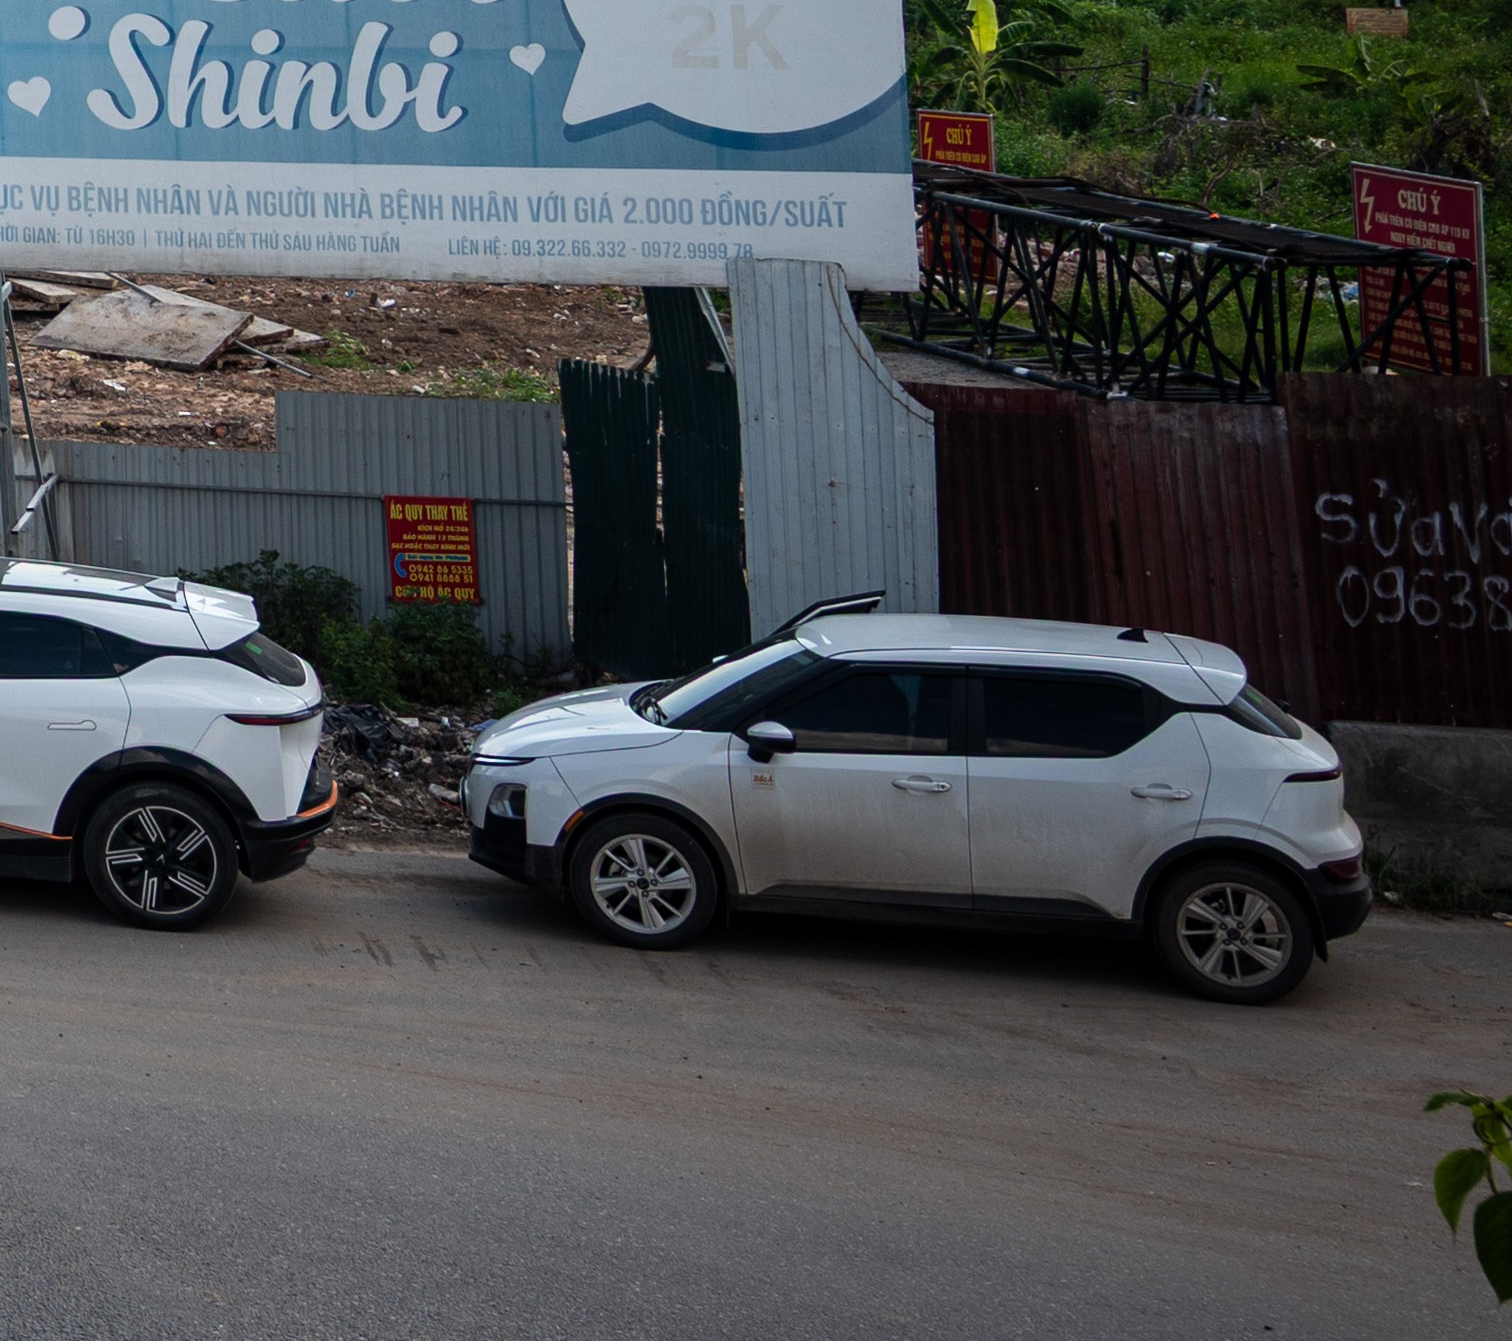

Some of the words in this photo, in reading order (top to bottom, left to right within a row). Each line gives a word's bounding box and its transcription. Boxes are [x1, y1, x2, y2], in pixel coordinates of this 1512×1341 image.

[670, 5, 791, 71] 2K
[86, 11, 467, 134] Shinbi
[946, 124, 964, 145] CHÚ
[965, 124, 972, 146] Ý
[29, 185, 61, 217] VỤ
[66, 180, 129, 218] BỆNH
[135, 181, 201, 215] NHÂN
[207, 184, 239, 216] VÀ
[245, 185, 316, 219] NGƯỜI
[322, 183, 373, 220] NHÀ
[380, 188, 444, 226] BỆNH
[451, 189, 518, 223] NHÂN
[526, 190, 566, 224] VỚI
[573, 189, 614, 225] GIÁ
[623, 197, 694, 226] 2.000
[700, 190, 848, 229] ĐỒNG/SUẤT
[1397, 187, 1427, 213] CHÚ
[1430, 189, 1441, 215] Ý
[22, 226, 61, 245] GIAN:
[64, 224, 85, 245] TỪ
[88, 229, 136, 247] 16H30
[155, 226, 184, 249] THỨ
[187, 231, 213, 249] HAI
[216, 225, 247, 250] ĐẾN
[250, 226, 280, 251] THỨ
[282, 228, 313, 252] SÁU
[316, 228, 358, 253] HÀNG
[360, 230, 400, 254] TUẦN
[447, 232, 480, 256] LIÊN
[511, 238, 626, 259] 09.322.66.332
[641, 240, 754, 260] 0972.999978
[405, 504, 423, 522] QUY
[425, 504, 448, 521] THAY
[409, 564, 434, 573] 0942
[410, 573, 434, 582] 0941
[454, 587, 475, 600] QUY
